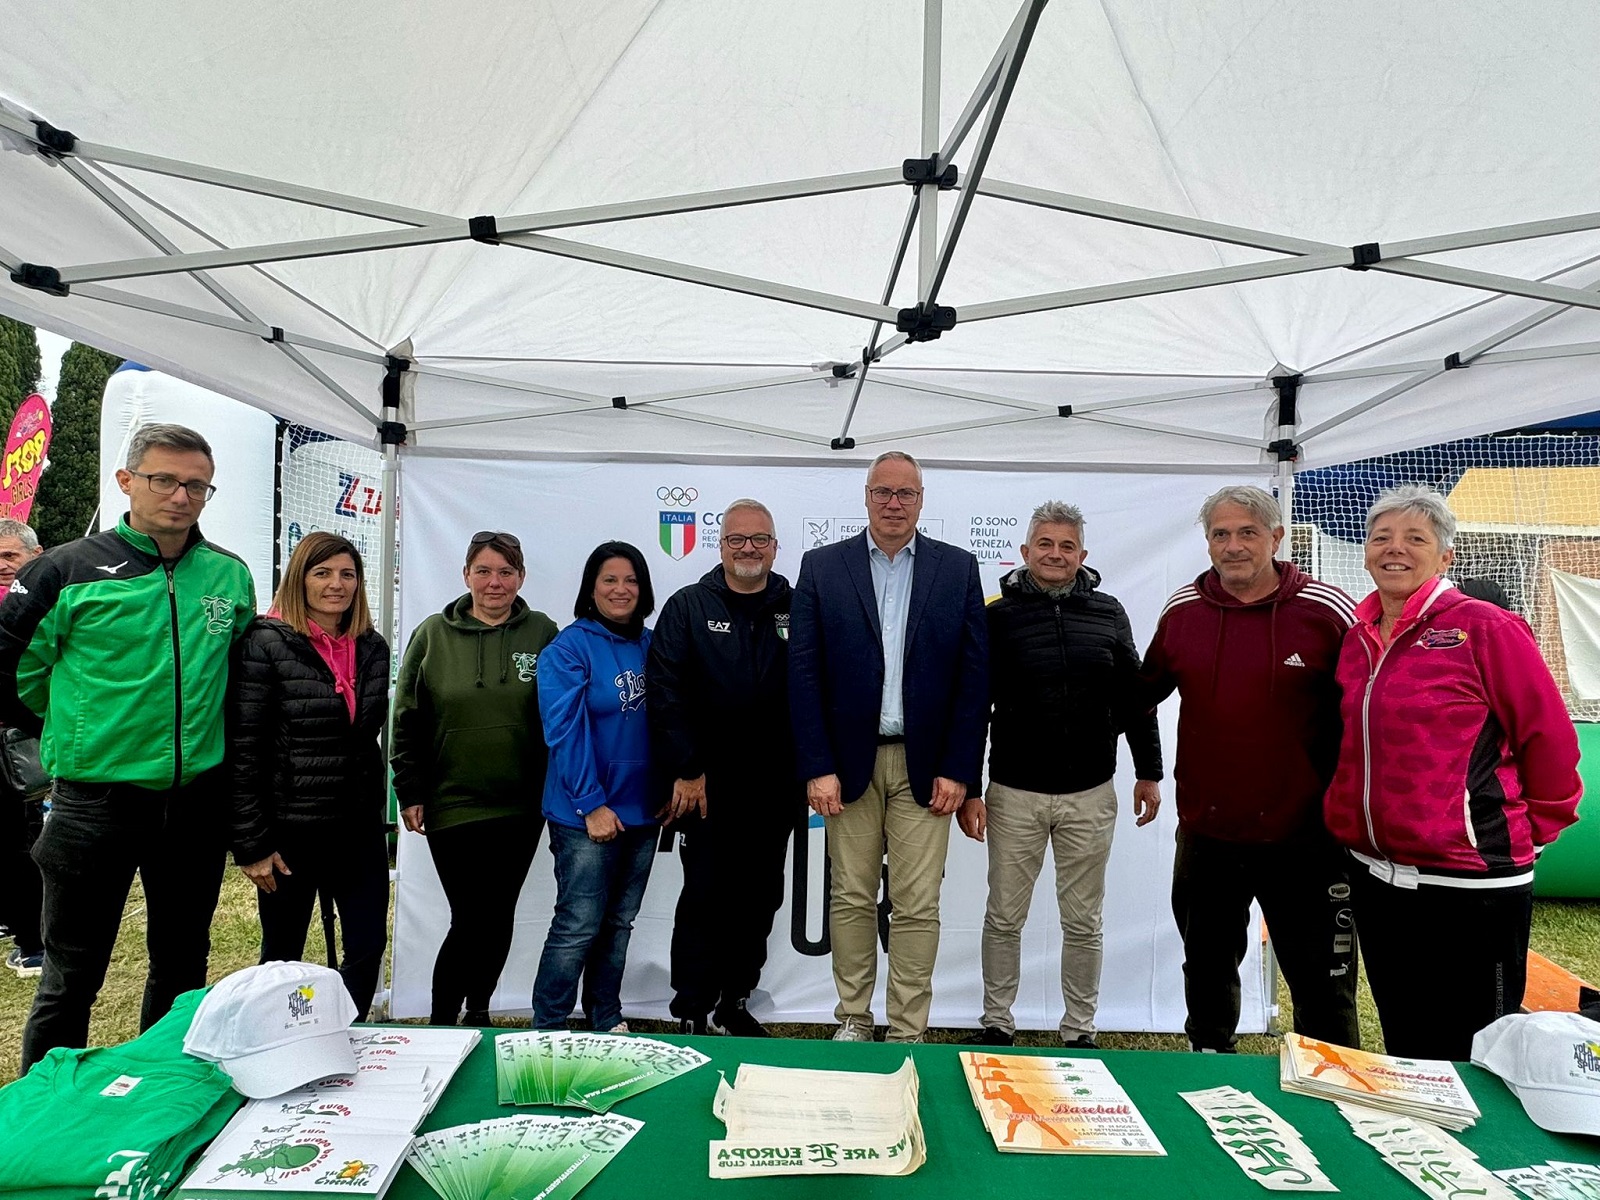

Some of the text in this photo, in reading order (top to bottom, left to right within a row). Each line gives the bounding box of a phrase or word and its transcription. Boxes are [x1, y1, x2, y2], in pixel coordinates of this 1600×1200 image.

[662, 514, 693, 523] ITALIA
[971, 516, 1018, 527] IO SONO
[970, 528, 999, 537] FRIULI
[702, 535, 720, 543] REG
[970, 538, 1013, 549] VENEZIA
[707, 620, 731, 632] EA7
[1366, 1065, 1454, 1083] Baseball
[1050, 1103, 1132, 1115] Baseball
[1084, 1114, 1125, 1124] Federico
